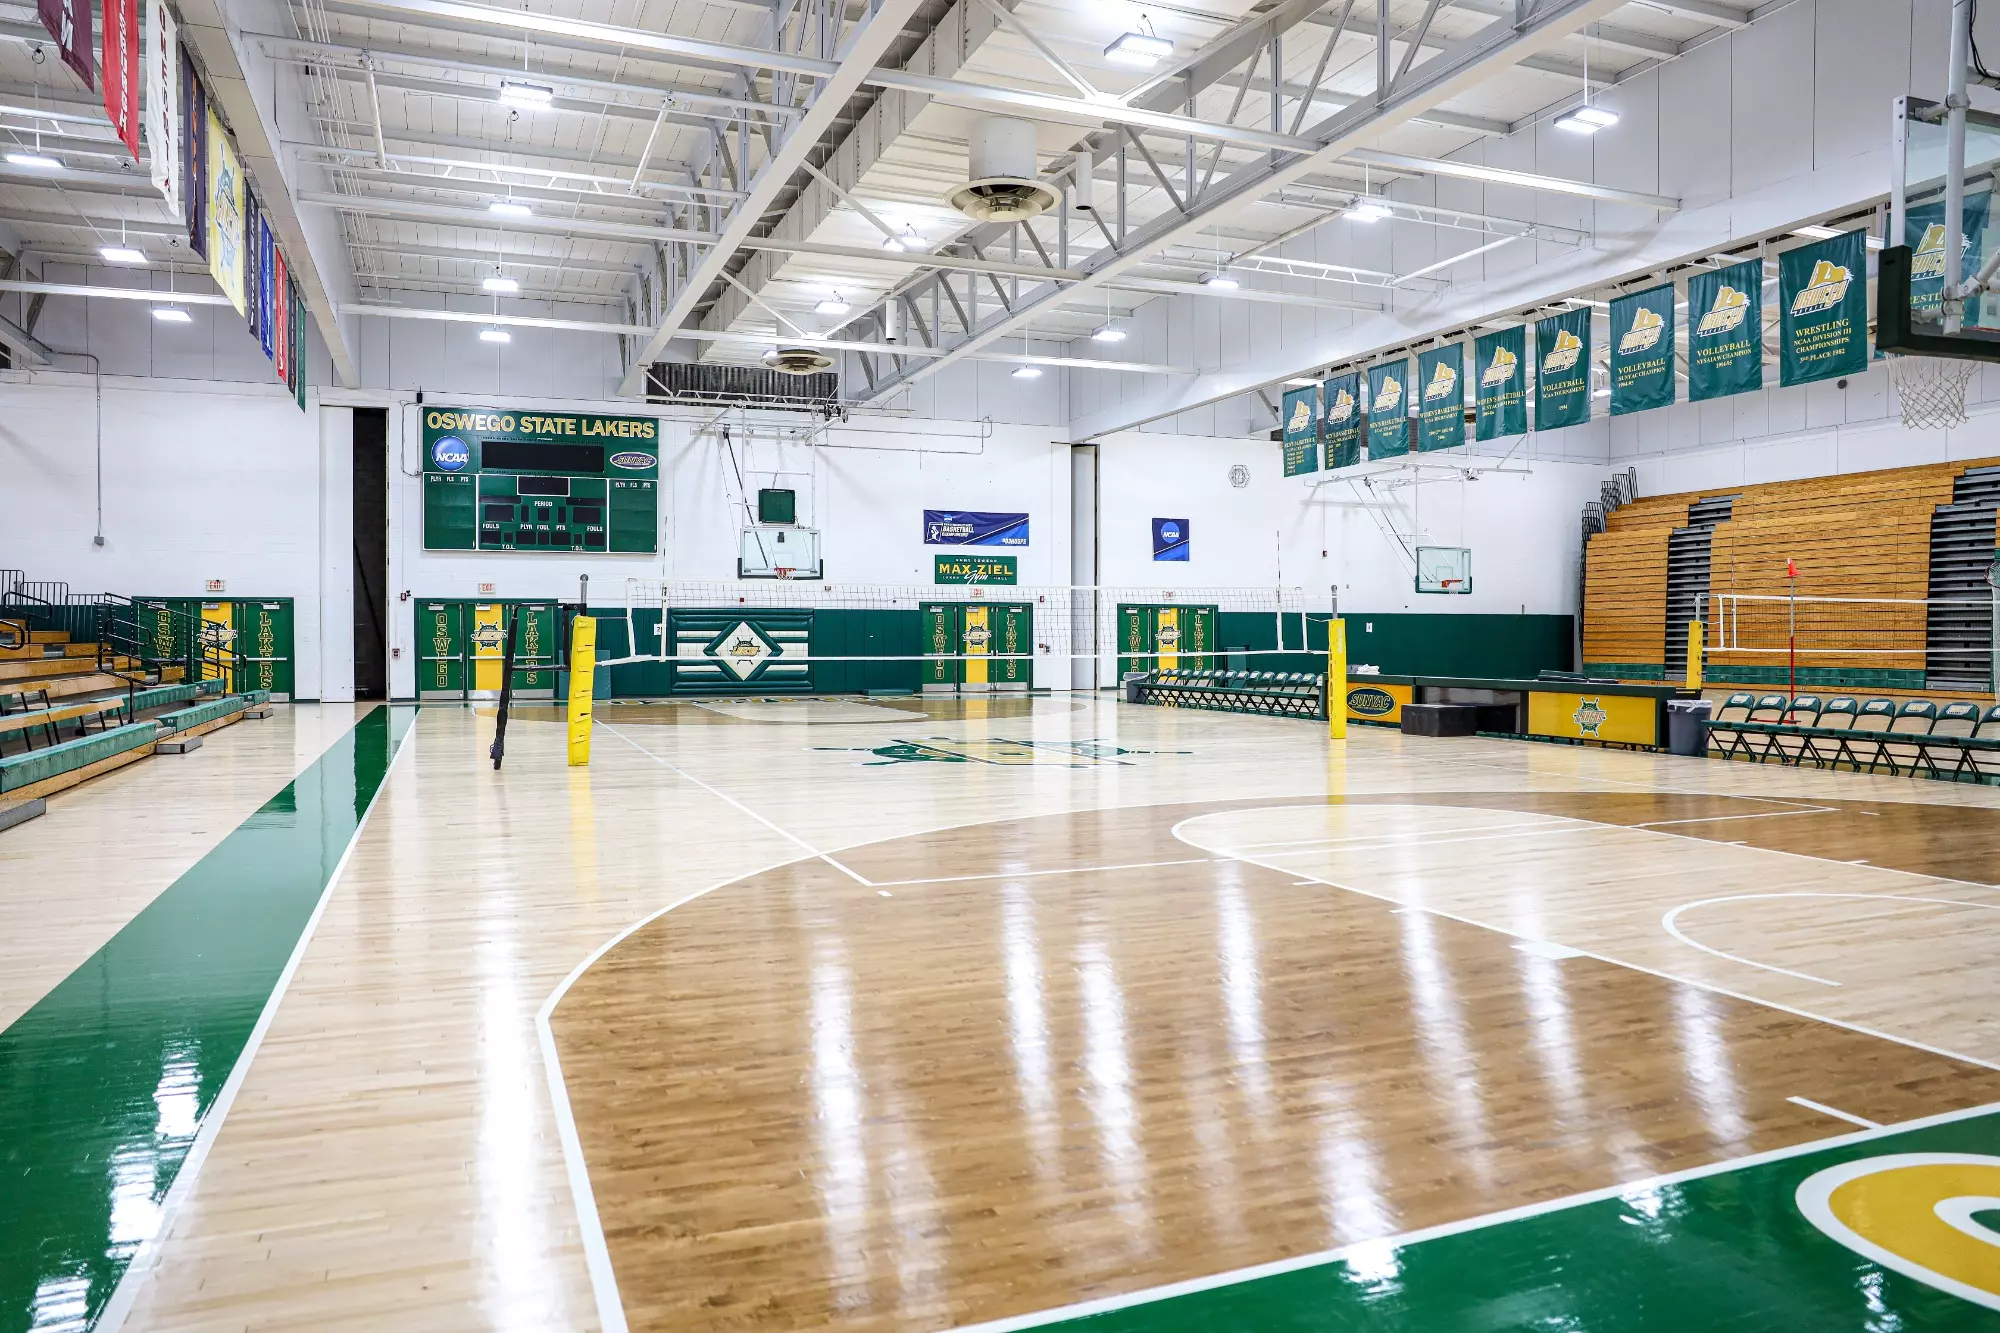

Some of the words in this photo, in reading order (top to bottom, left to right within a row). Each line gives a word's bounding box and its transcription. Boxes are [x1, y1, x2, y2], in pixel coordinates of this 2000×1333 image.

[1795, 318, 1849, 337] WRESTLING
[1793, 337, 1812, 346] NCAA
[1813, 329, 1842, 342] DIVISION
[1796, 336, 1849, 353] CHAMPIONSHIPS
[1696, 340, 1751, 357] VOLLEYBALL
[1722, 348, 1752, 359] CHAMPION
[1810, 351, 1831, 361] PLACE
[1618, 358, 1666, 374] VOLLEYBALL
[1618, 373, 1639, 381] SUNYAC
[1639, 366, 1665, 376] CHAMPION
[1543, 378, 1585, 392] VOLLEYBALL
[1553, 386, 1586, 397] TOURNAMENT
[427, 411, 516, 432] OSWEGO
[520, 416, 577, 435] STATE
[581, 419, 656, 439] LAKERS
[435, 452, 469, 463] NCAA
[941, 525, 975, 533] BASKETBALL
[939, 564, 971, 575] MAX
[977, 565, 1013, 575] ZIEL
[258, 612, 273, 689] LAKERS
[433, 613, 451, 687] OSWEGO
[1349, 694, 1391, 709] SUNYAC
